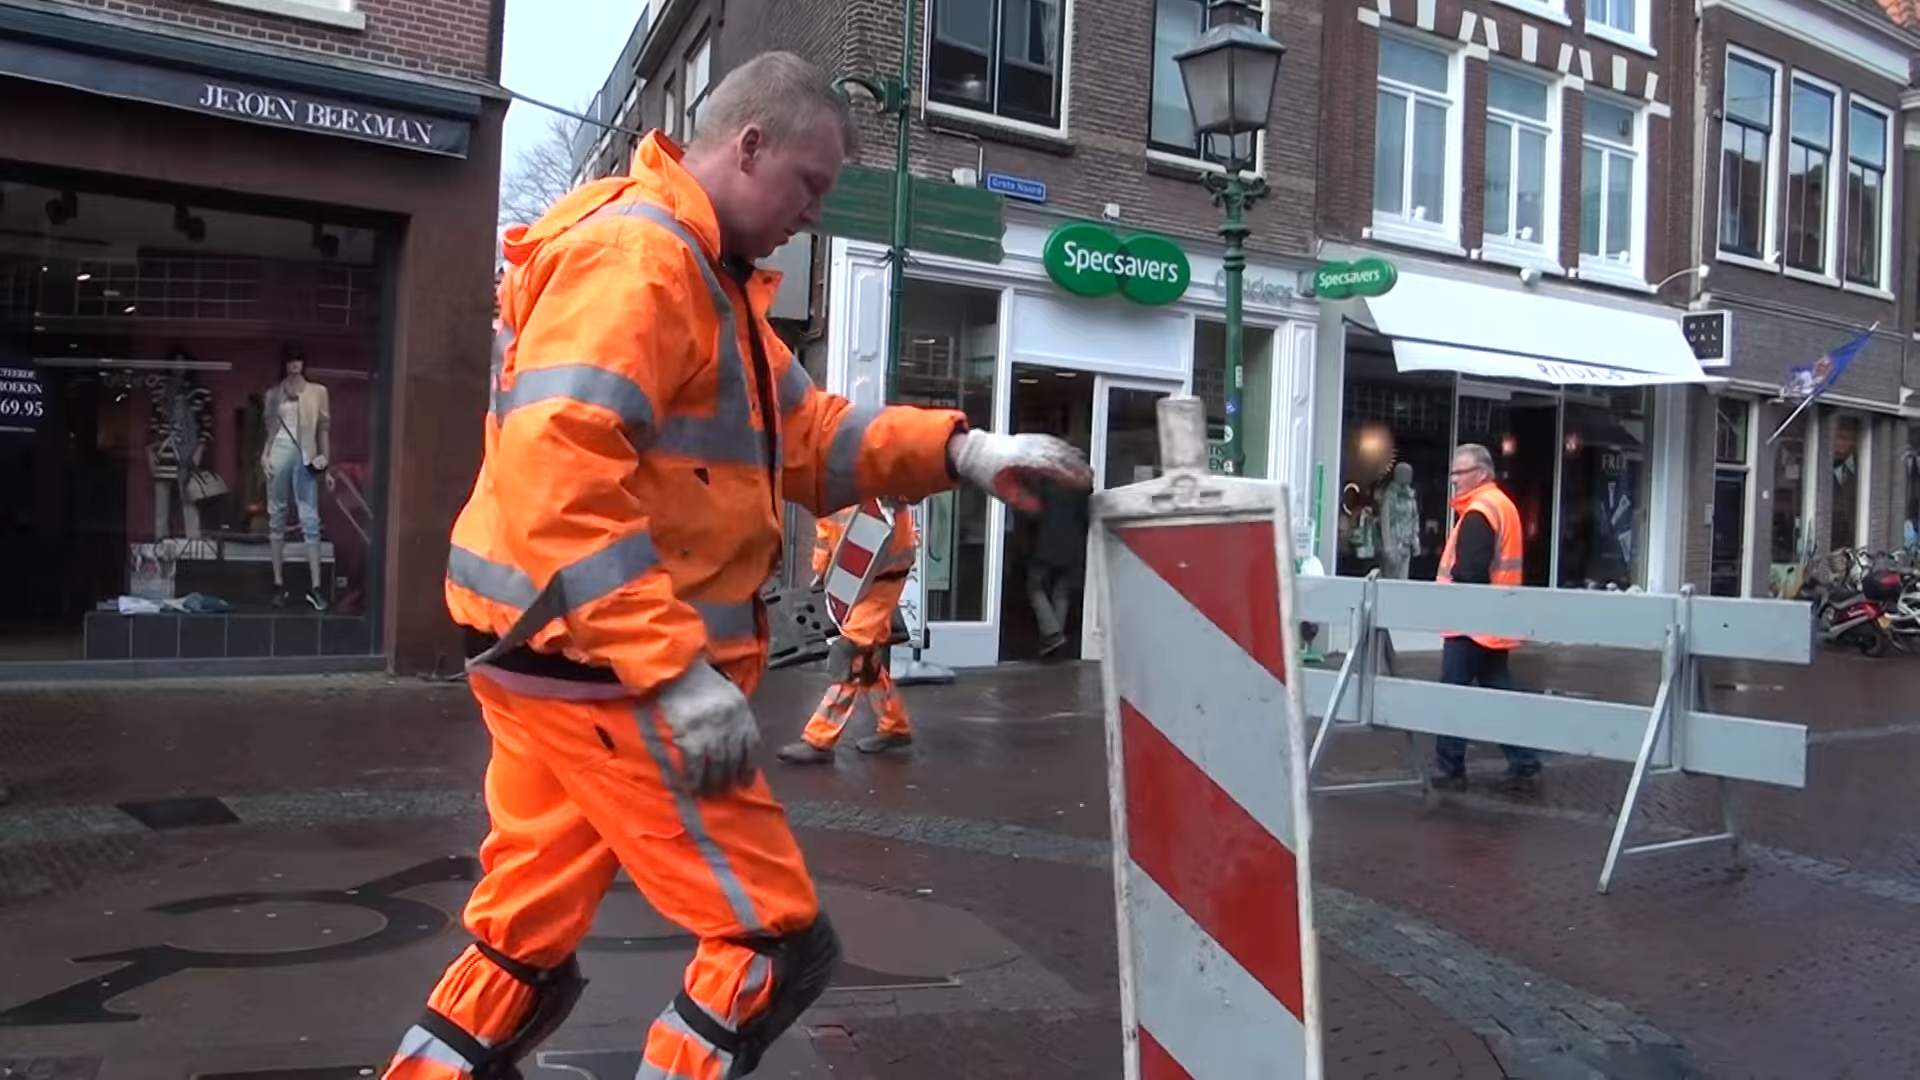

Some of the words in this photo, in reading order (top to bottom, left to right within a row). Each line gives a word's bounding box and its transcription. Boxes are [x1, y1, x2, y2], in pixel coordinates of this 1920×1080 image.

[200, 83, 297, 122] JEROEN
[306, 103, 432, 145] BEEKMAN
[1063, 240, 1179, 284] Specsavers
[1319, 269, 1380, 289] Specsavers
[0, 398, 44, 417] 69.95
